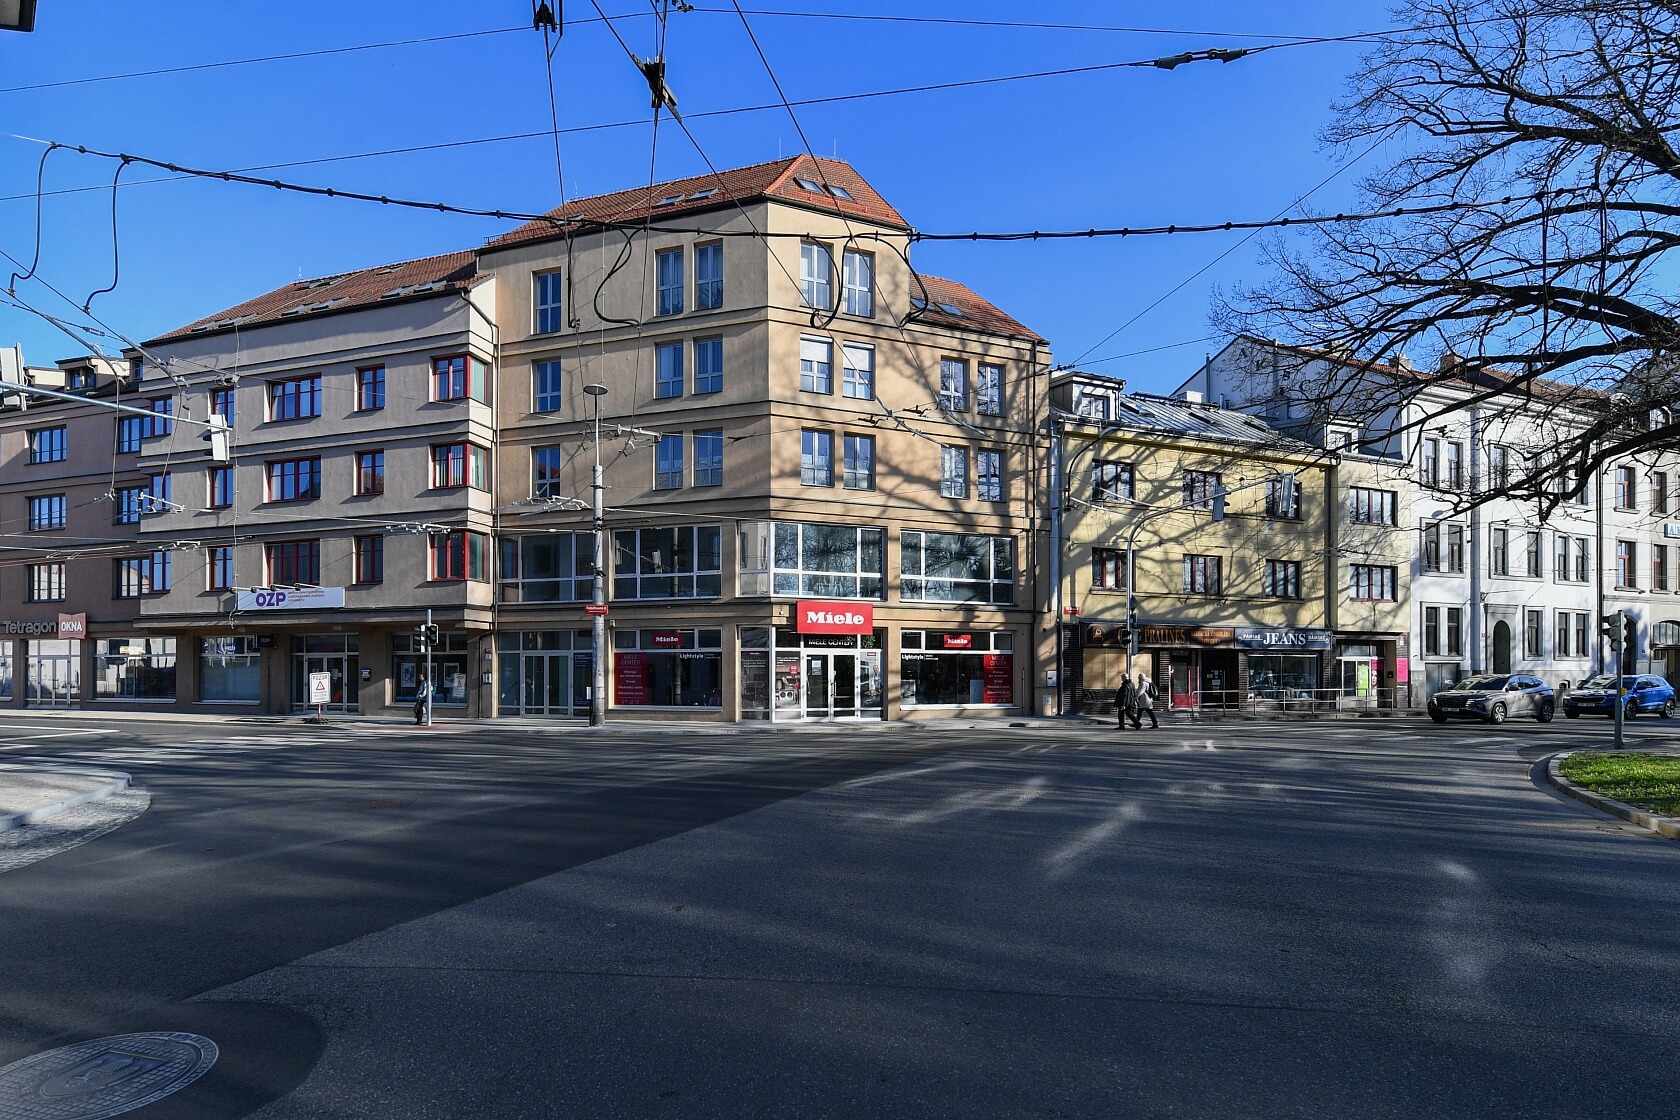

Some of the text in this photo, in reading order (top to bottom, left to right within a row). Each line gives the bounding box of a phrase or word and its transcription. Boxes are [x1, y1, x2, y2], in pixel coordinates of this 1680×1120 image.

[255, 592, 287, 607] OZP
[806, 611, 865, 625] Miele
[3, 620, 83, 635] Tetragon OKNA
[808, 638, 827, 646] MIELE
[1144, 629, 1185, 644] PRALINES
[1263, 632, 1306, 645] JEANS
